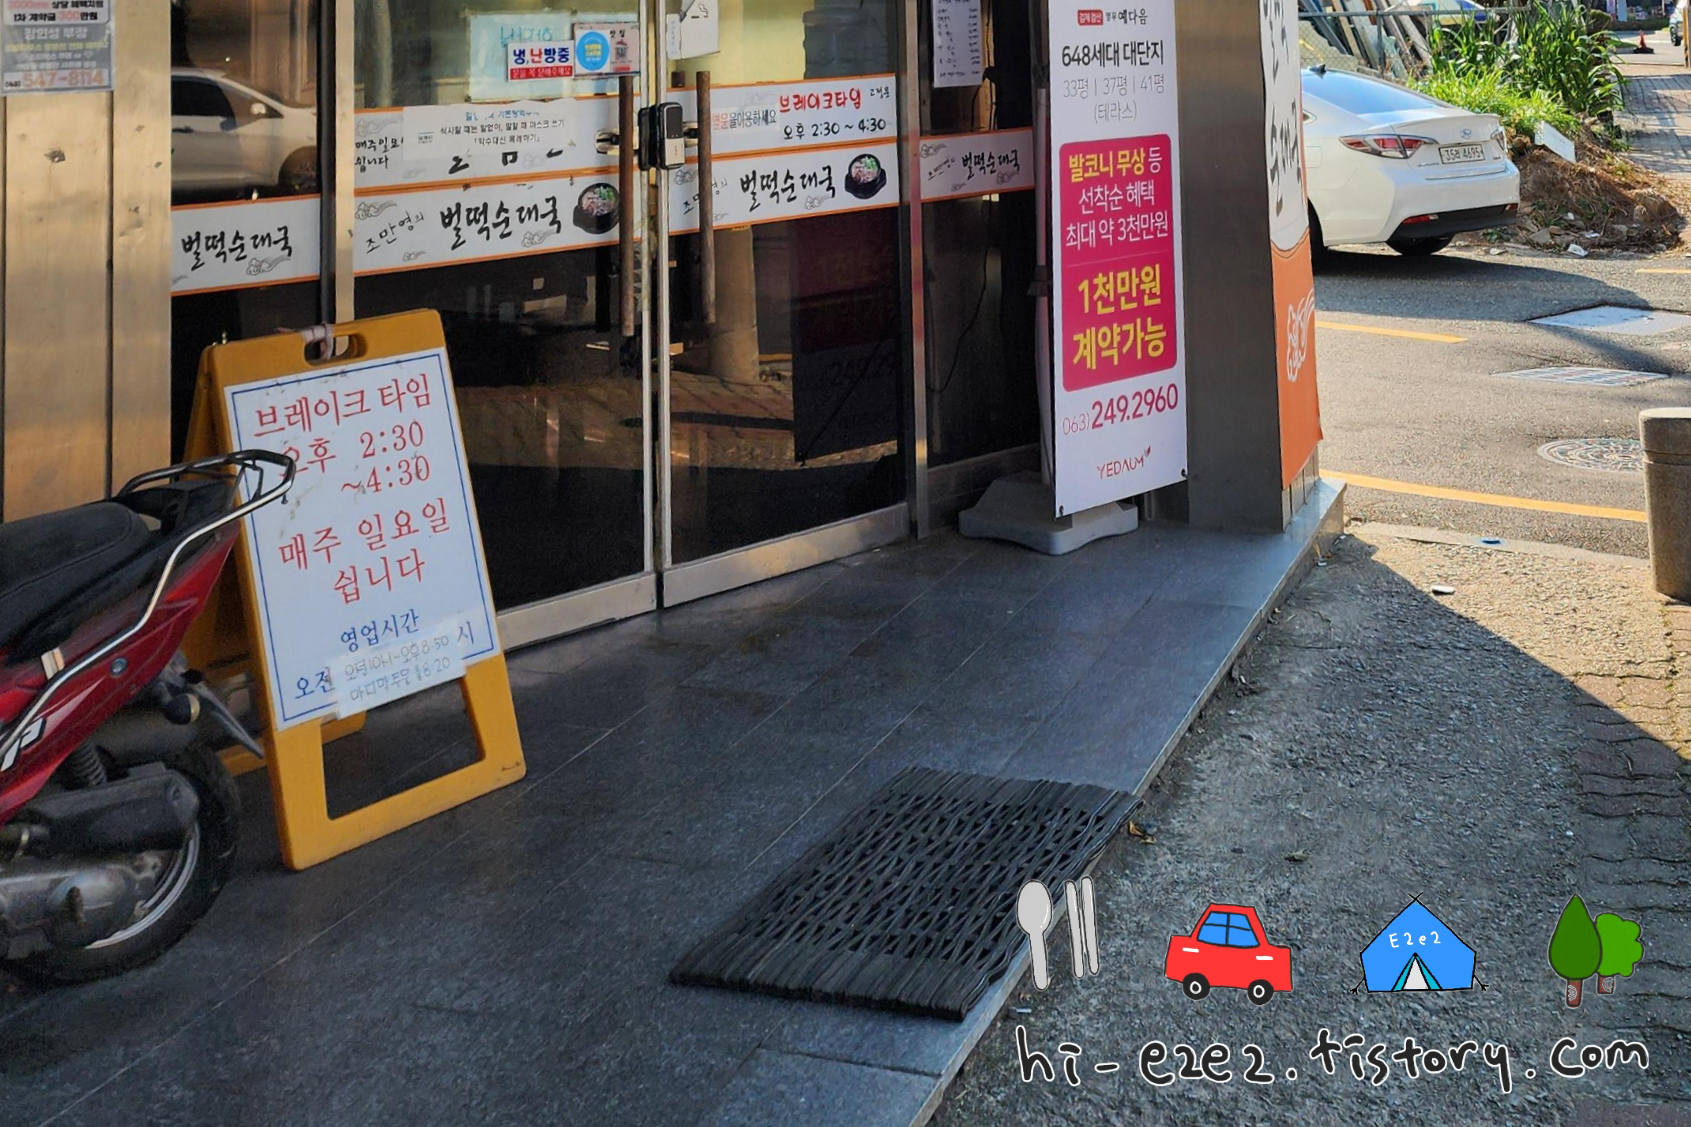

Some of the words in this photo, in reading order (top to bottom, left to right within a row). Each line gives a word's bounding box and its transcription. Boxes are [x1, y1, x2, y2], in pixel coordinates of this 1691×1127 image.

[513, 47, 570, 65] 냉,난방중
[1062, 43, 1120, 68] 648세대
[1123, 40, 1164, 66] 대단지
[1063, 78, 1089, 99] 33평
[1103, 75, 1128, 96] 37평
[1140, 73, 1165, 94] 41평
[783, 123, 805, 140] 오후
[812, 121, 840, 137] 2:30
[858, 117, 887, 133] 4:30
[1093, 100, 1138, 123] (테라스)
[355, 137, 404, 153] 매주일요
[962, 149, 1020, 181] 벌떡순대국
[1069, 151, 1113, 183] 발코니
[1117, 147, 1145, 176] 무상
[1148, 147, 1163, 174] 등
[740, 165, 836, 212] 벌떡순대국
[1079, 184, 1124, 214] 선착순
[1126, 179, 1155, 207] 혜택
[366, 210, 425, 254] 조만영의
[440, 195, 562, 251] 벌떡순대국
[1066, 220, 1096, 250] 최대
[1098, 218, 1114, 246] 약
[1117, 210, 1169, 242] 3천만원
[181, 225, 293, 272] 벌떡순대국
[1078, 263, 1162, 315] 1천만원
[1072, 317, 1168, 370] 계약가능
[254, 390, 371, 437] 브레이크
[377, 373, 431, 413] 타임
[360, 420, 424, 459] 2:30
[278, 527, 342, 571] 매주
[358, 497, 450, 551] 일요일
[333, 548, 426, 604] 쉽니다
[340, 609, 419, 652] 영업시간
[457, 621, 474, 645] 시
